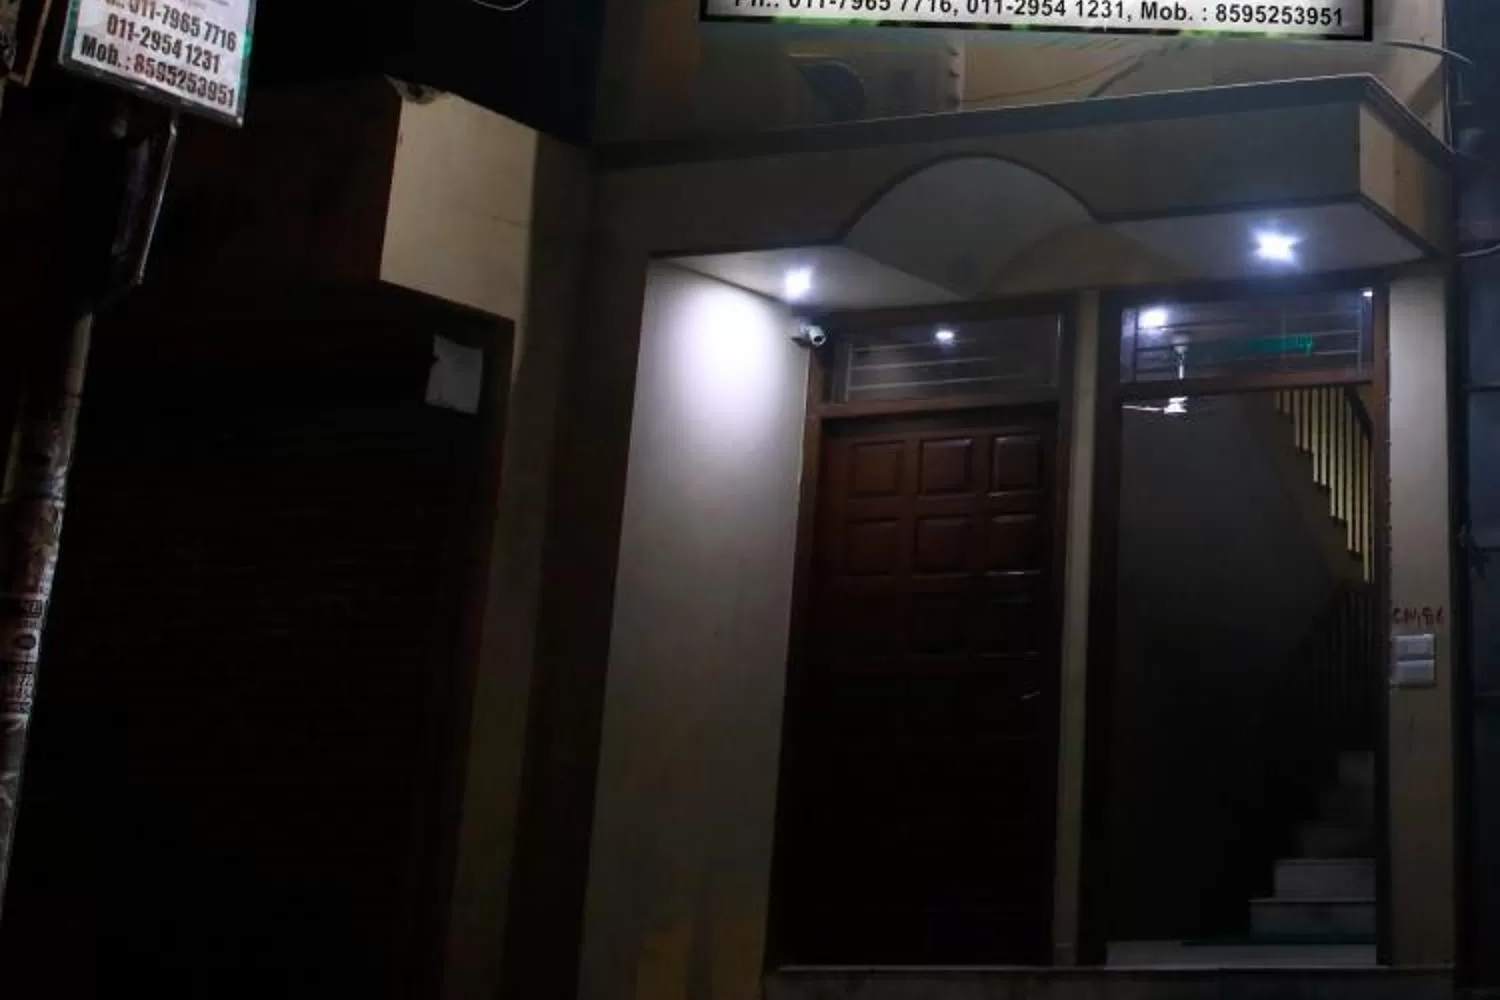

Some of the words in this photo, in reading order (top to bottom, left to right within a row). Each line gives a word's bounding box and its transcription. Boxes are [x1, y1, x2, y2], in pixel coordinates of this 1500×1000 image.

[1075, 0, 1132, 22] 1231,
[1215, 3, 1344, 27] 8595253951
[106, 13, 182, 60] 011-2954
[184, 43, 221, 75] 1231
[204, 21, 237, 52] 7716
[133, 52, 236, 110] 8595253951
